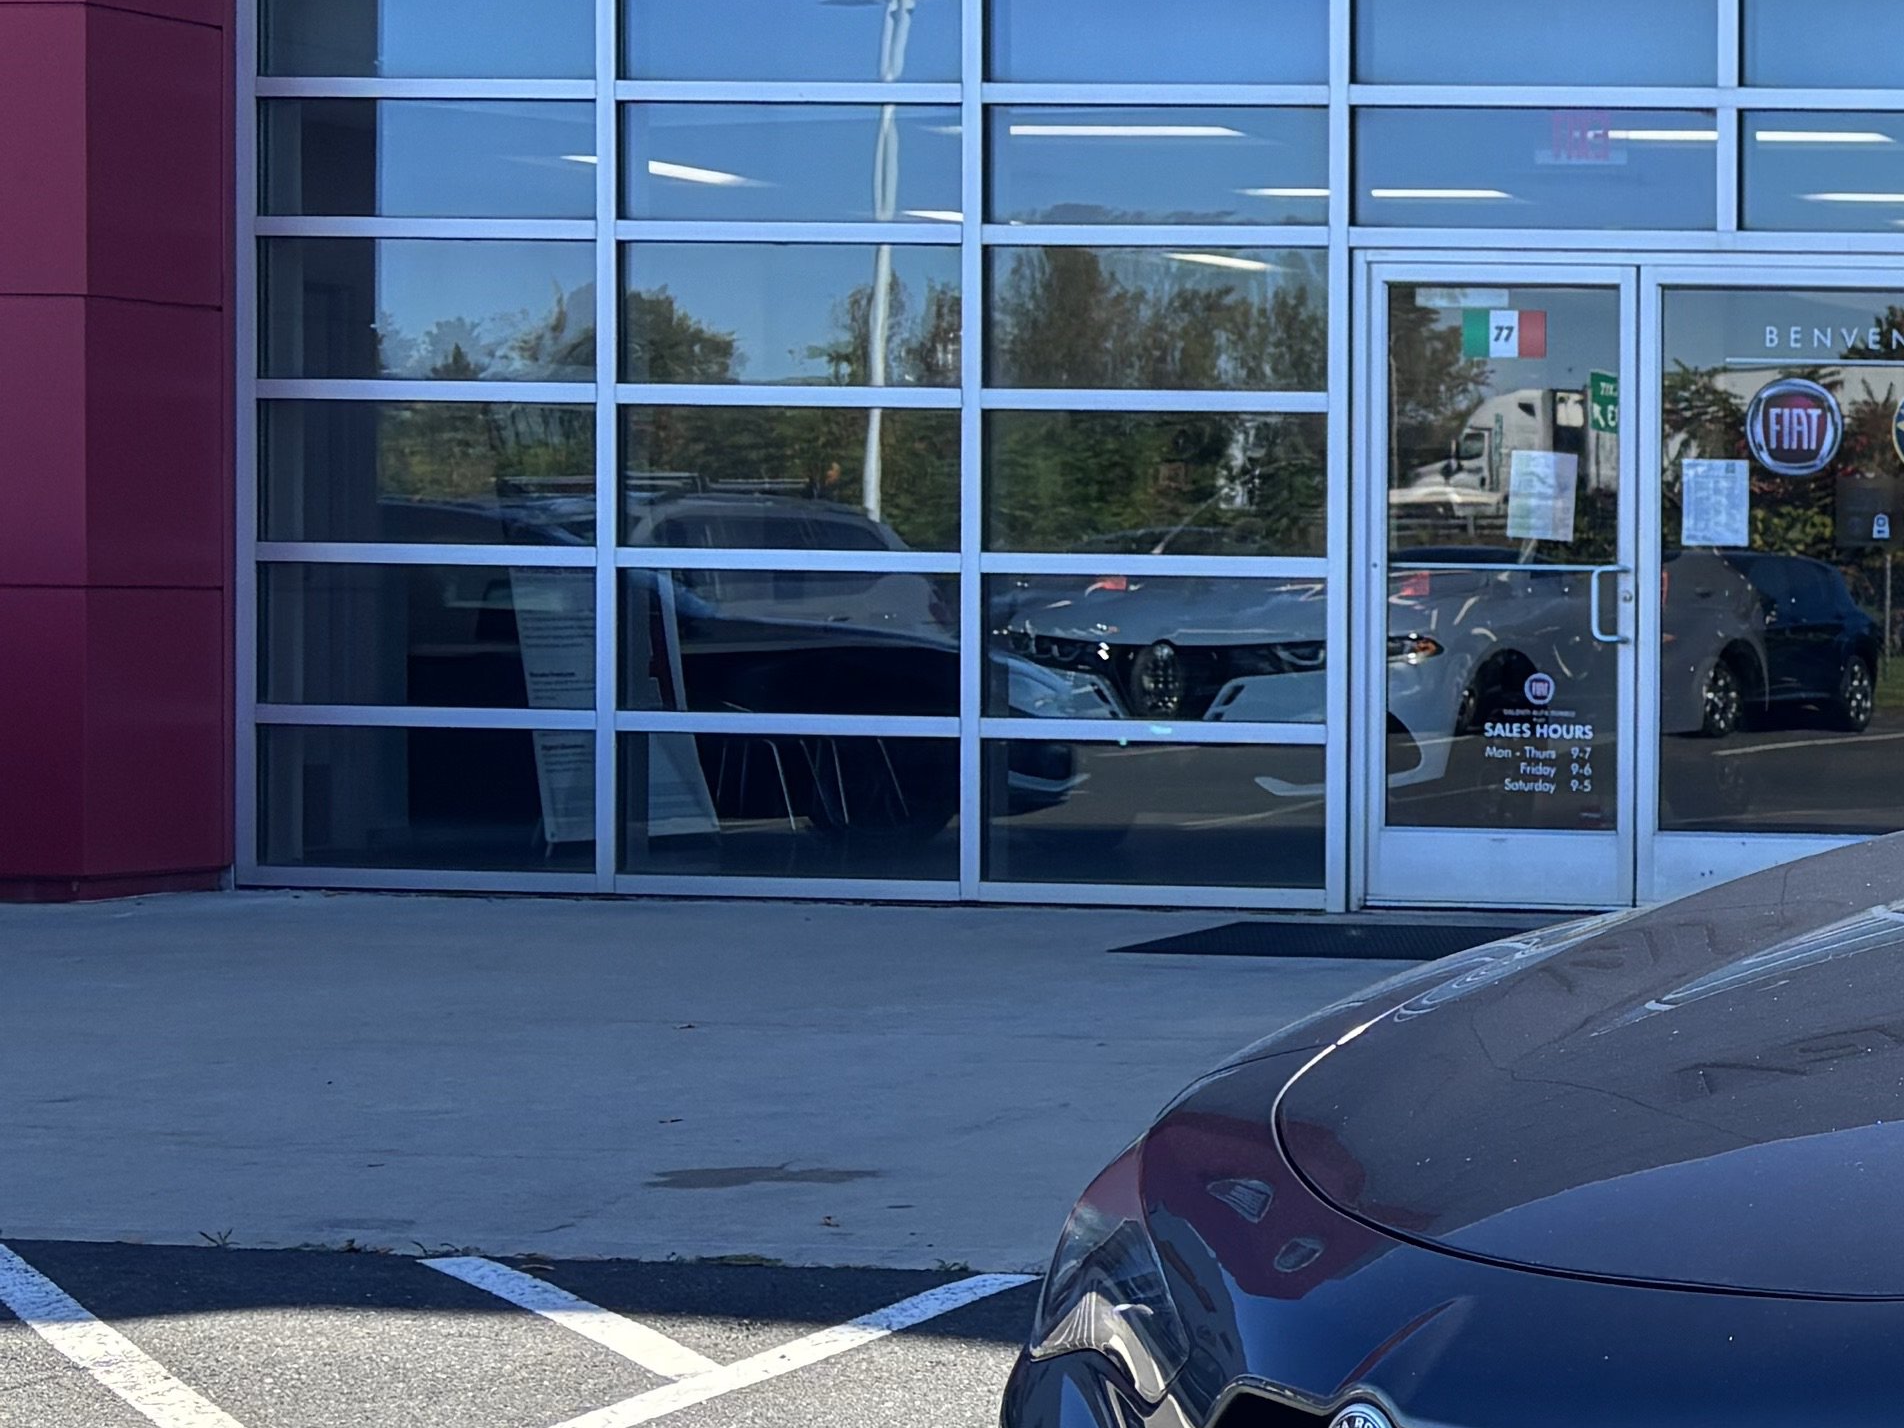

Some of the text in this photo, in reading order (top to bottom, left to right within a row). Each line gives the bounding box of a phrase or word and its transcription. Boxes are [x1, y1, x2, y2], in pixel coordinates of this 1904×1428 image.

[1493, 326, 1514, 342] 77
[1769, 408, 1823, 450] FIAT
[1484, 722, 1593, 740] SALES HOURS
[1485, 746, 1512, 758] Mon
[1520, 762, 1556, 778] Friday
[1504, 778, 1556, 794] Saturday
